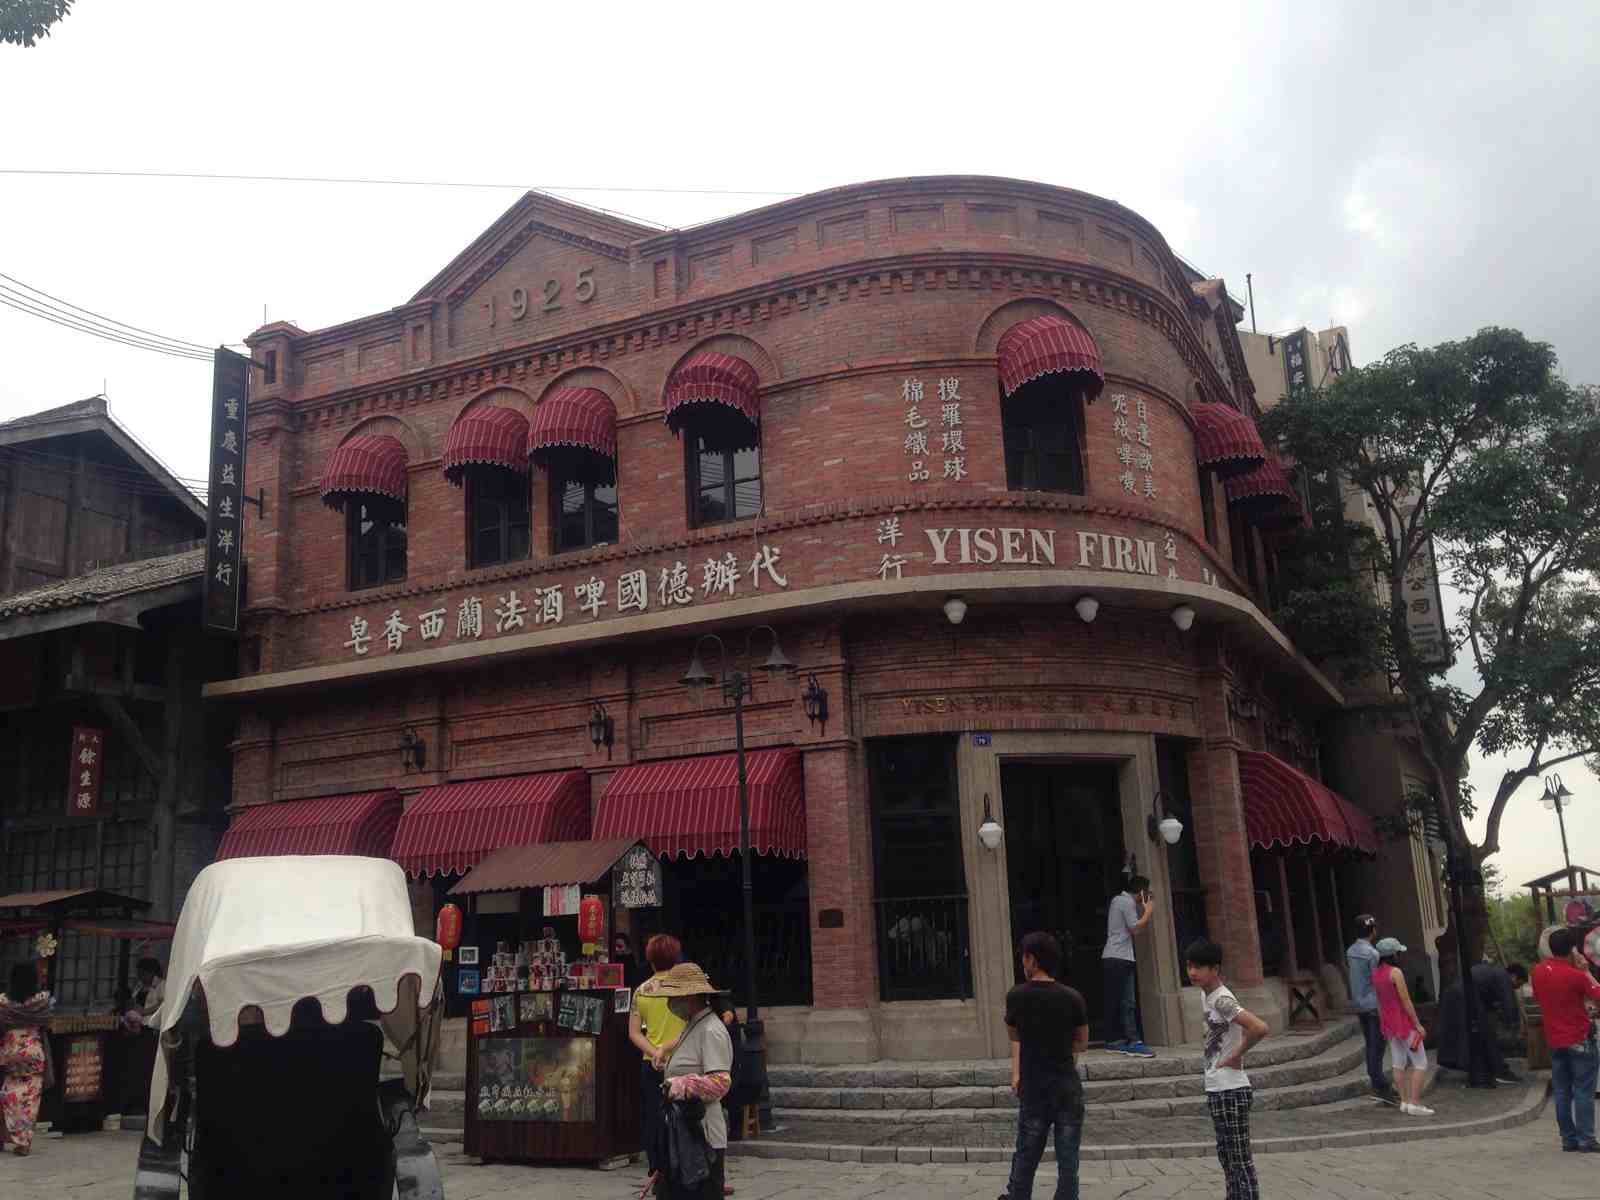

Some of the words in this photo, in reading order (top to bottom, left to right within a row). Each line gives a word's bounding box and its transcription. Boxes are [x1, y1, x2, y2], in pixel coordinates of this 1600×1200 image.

[484, 267, 595, 327] 1925
[876, 517, 908, 581] 洋行
[924, 527, 1056, 566] YISEN
[1076, 530, 1159, 576] FIRM
